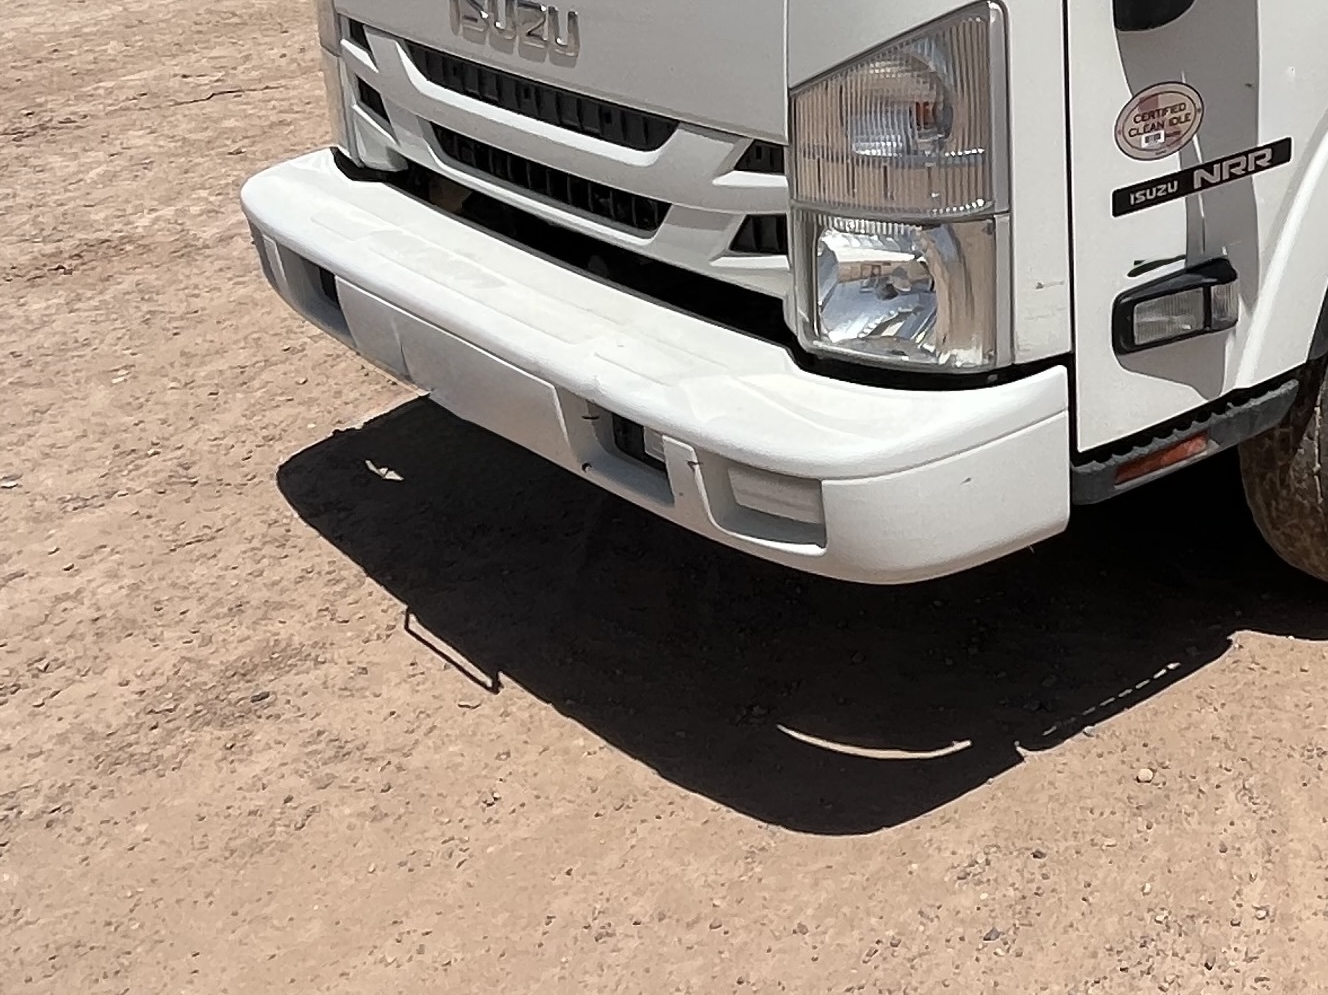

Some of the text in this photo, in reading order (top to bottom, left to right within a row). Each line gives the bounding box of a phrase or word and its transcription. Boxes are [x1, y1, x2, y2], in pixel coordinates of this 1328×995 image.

[1128, 112, 1192, 138] CLEAN IDLE
[1133, 102, 1187, 124] CERTIFIED
[1130, 147, 1273, 206] ISUZU NRR
